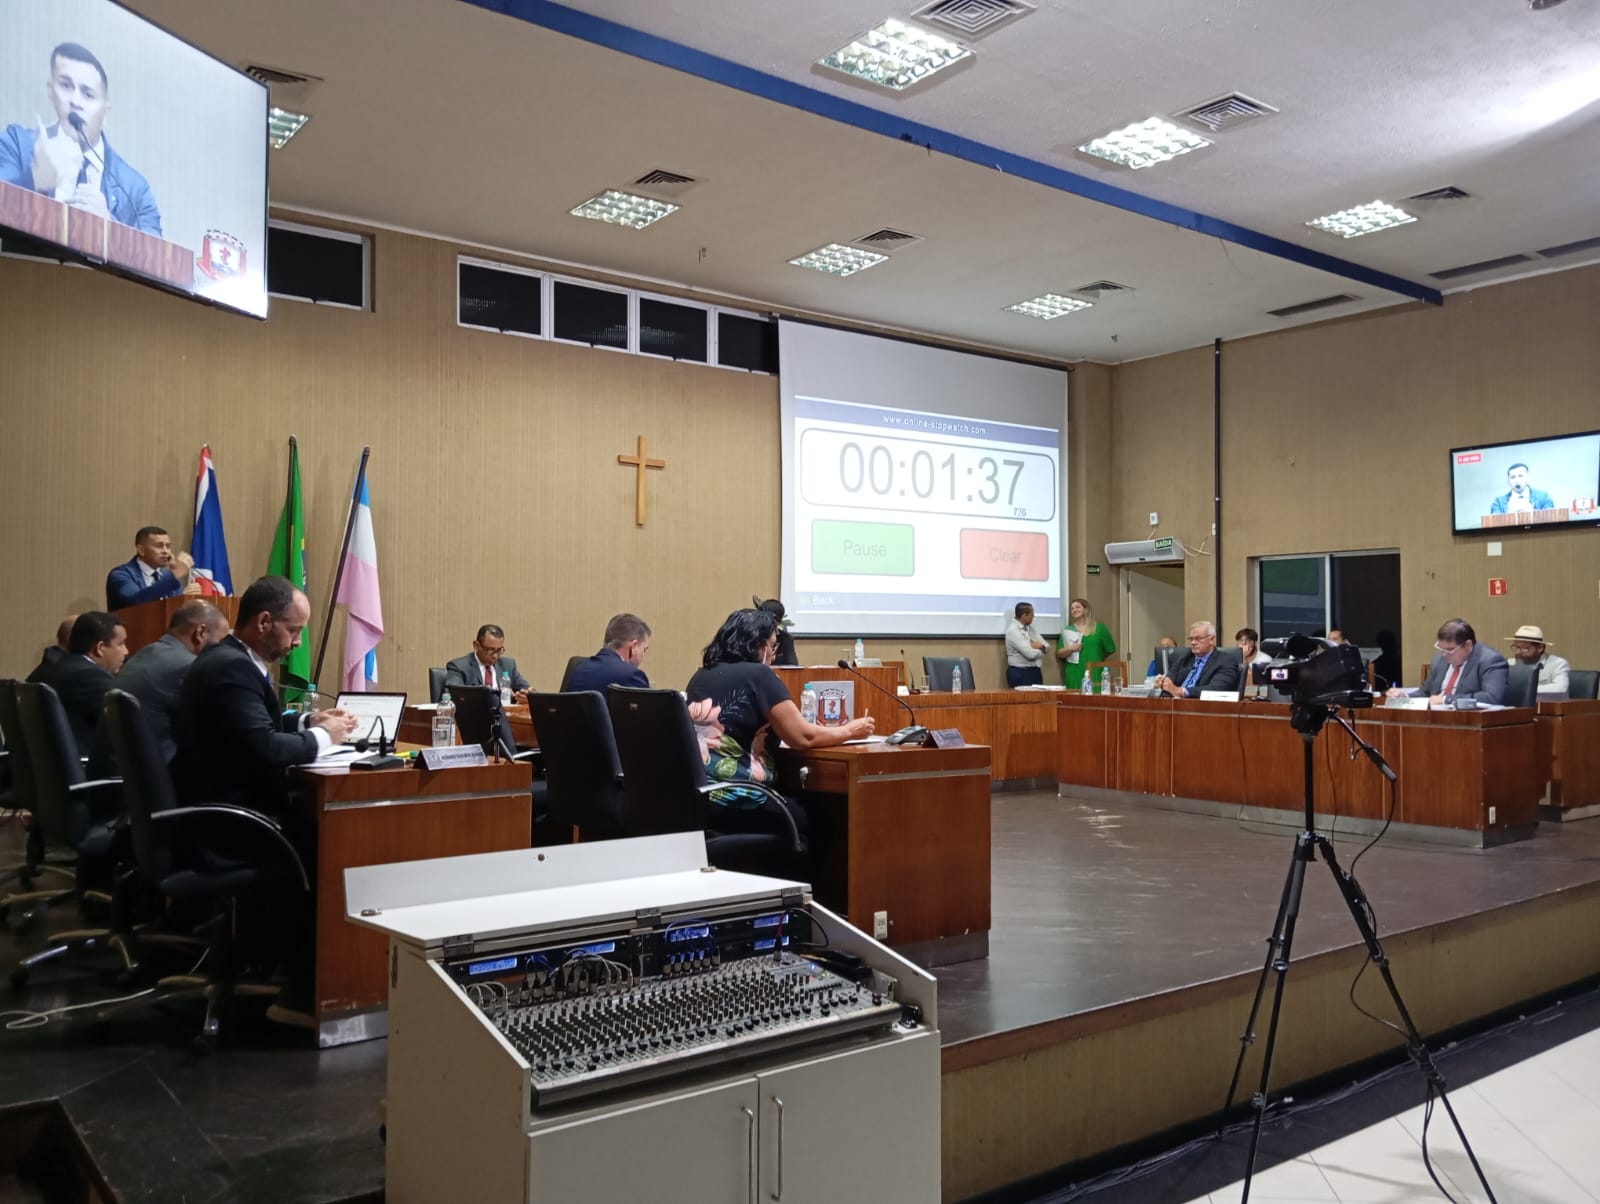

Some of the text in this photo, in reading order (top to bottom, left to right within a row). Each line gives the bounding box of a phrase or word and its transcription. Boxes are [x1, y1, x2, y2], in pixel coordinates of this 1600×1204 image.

[839, 442, 1025, 505] 00:01:37
[843, 539, 888, 557] Pause
[989, 547, 1022, 563] Clear
